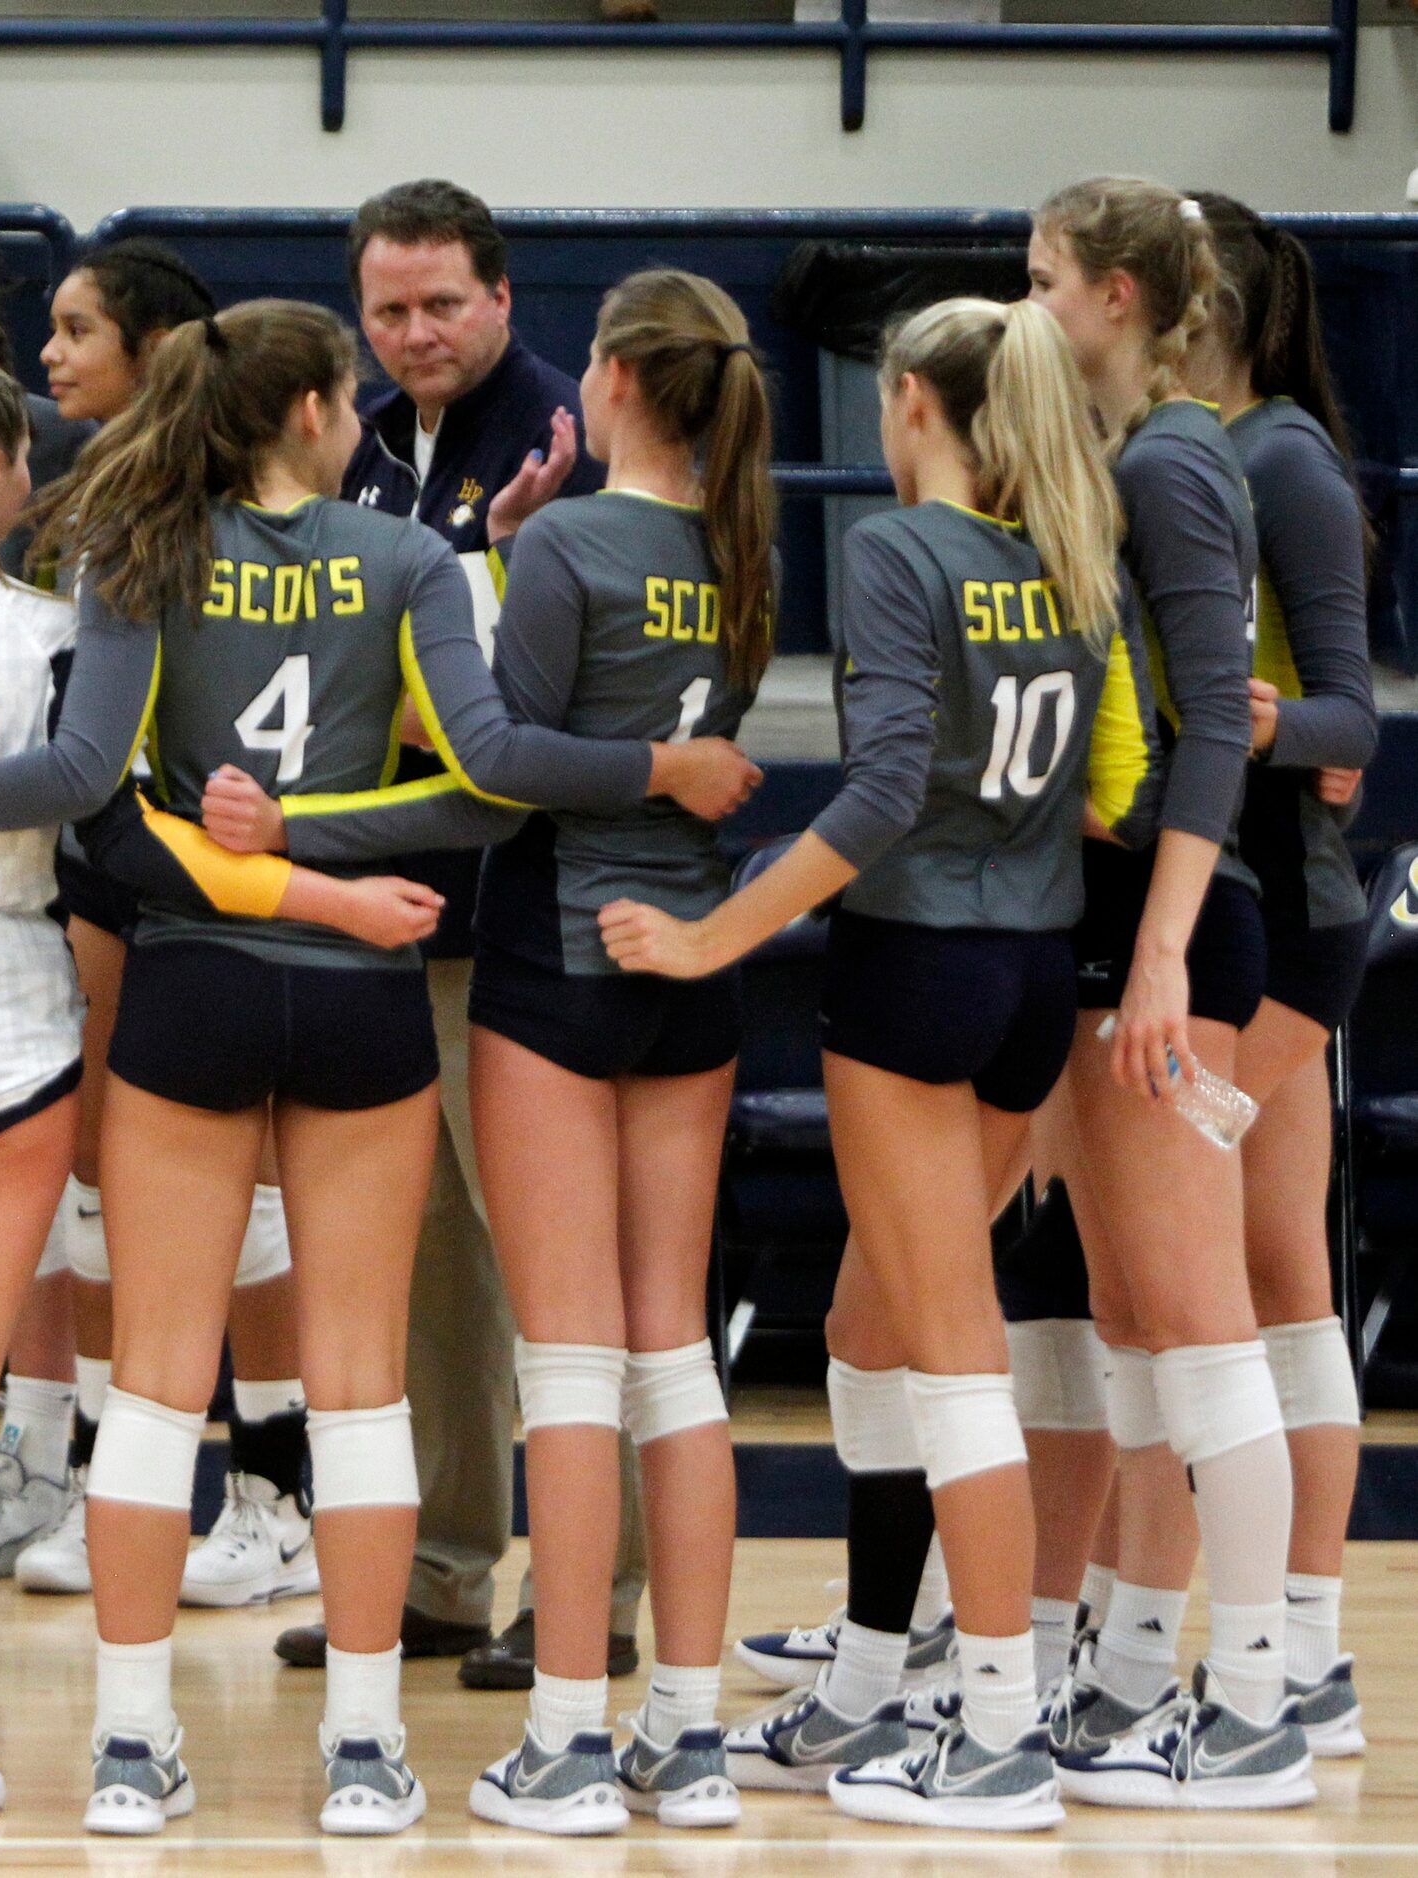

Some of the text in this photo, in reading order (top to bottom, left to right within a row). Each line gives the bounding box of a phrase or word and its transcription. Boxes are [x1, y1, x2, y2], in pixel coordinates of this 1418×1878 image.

[202, 556, 365, 624] SCOTS
[643, 575, 772, 644] SCO
[963, 579, 1083, 642] SCOT
[234, 653, 316, 783] 4
[667, 676, 712, 743] 1
[980, 670, 1075, 798] 10
